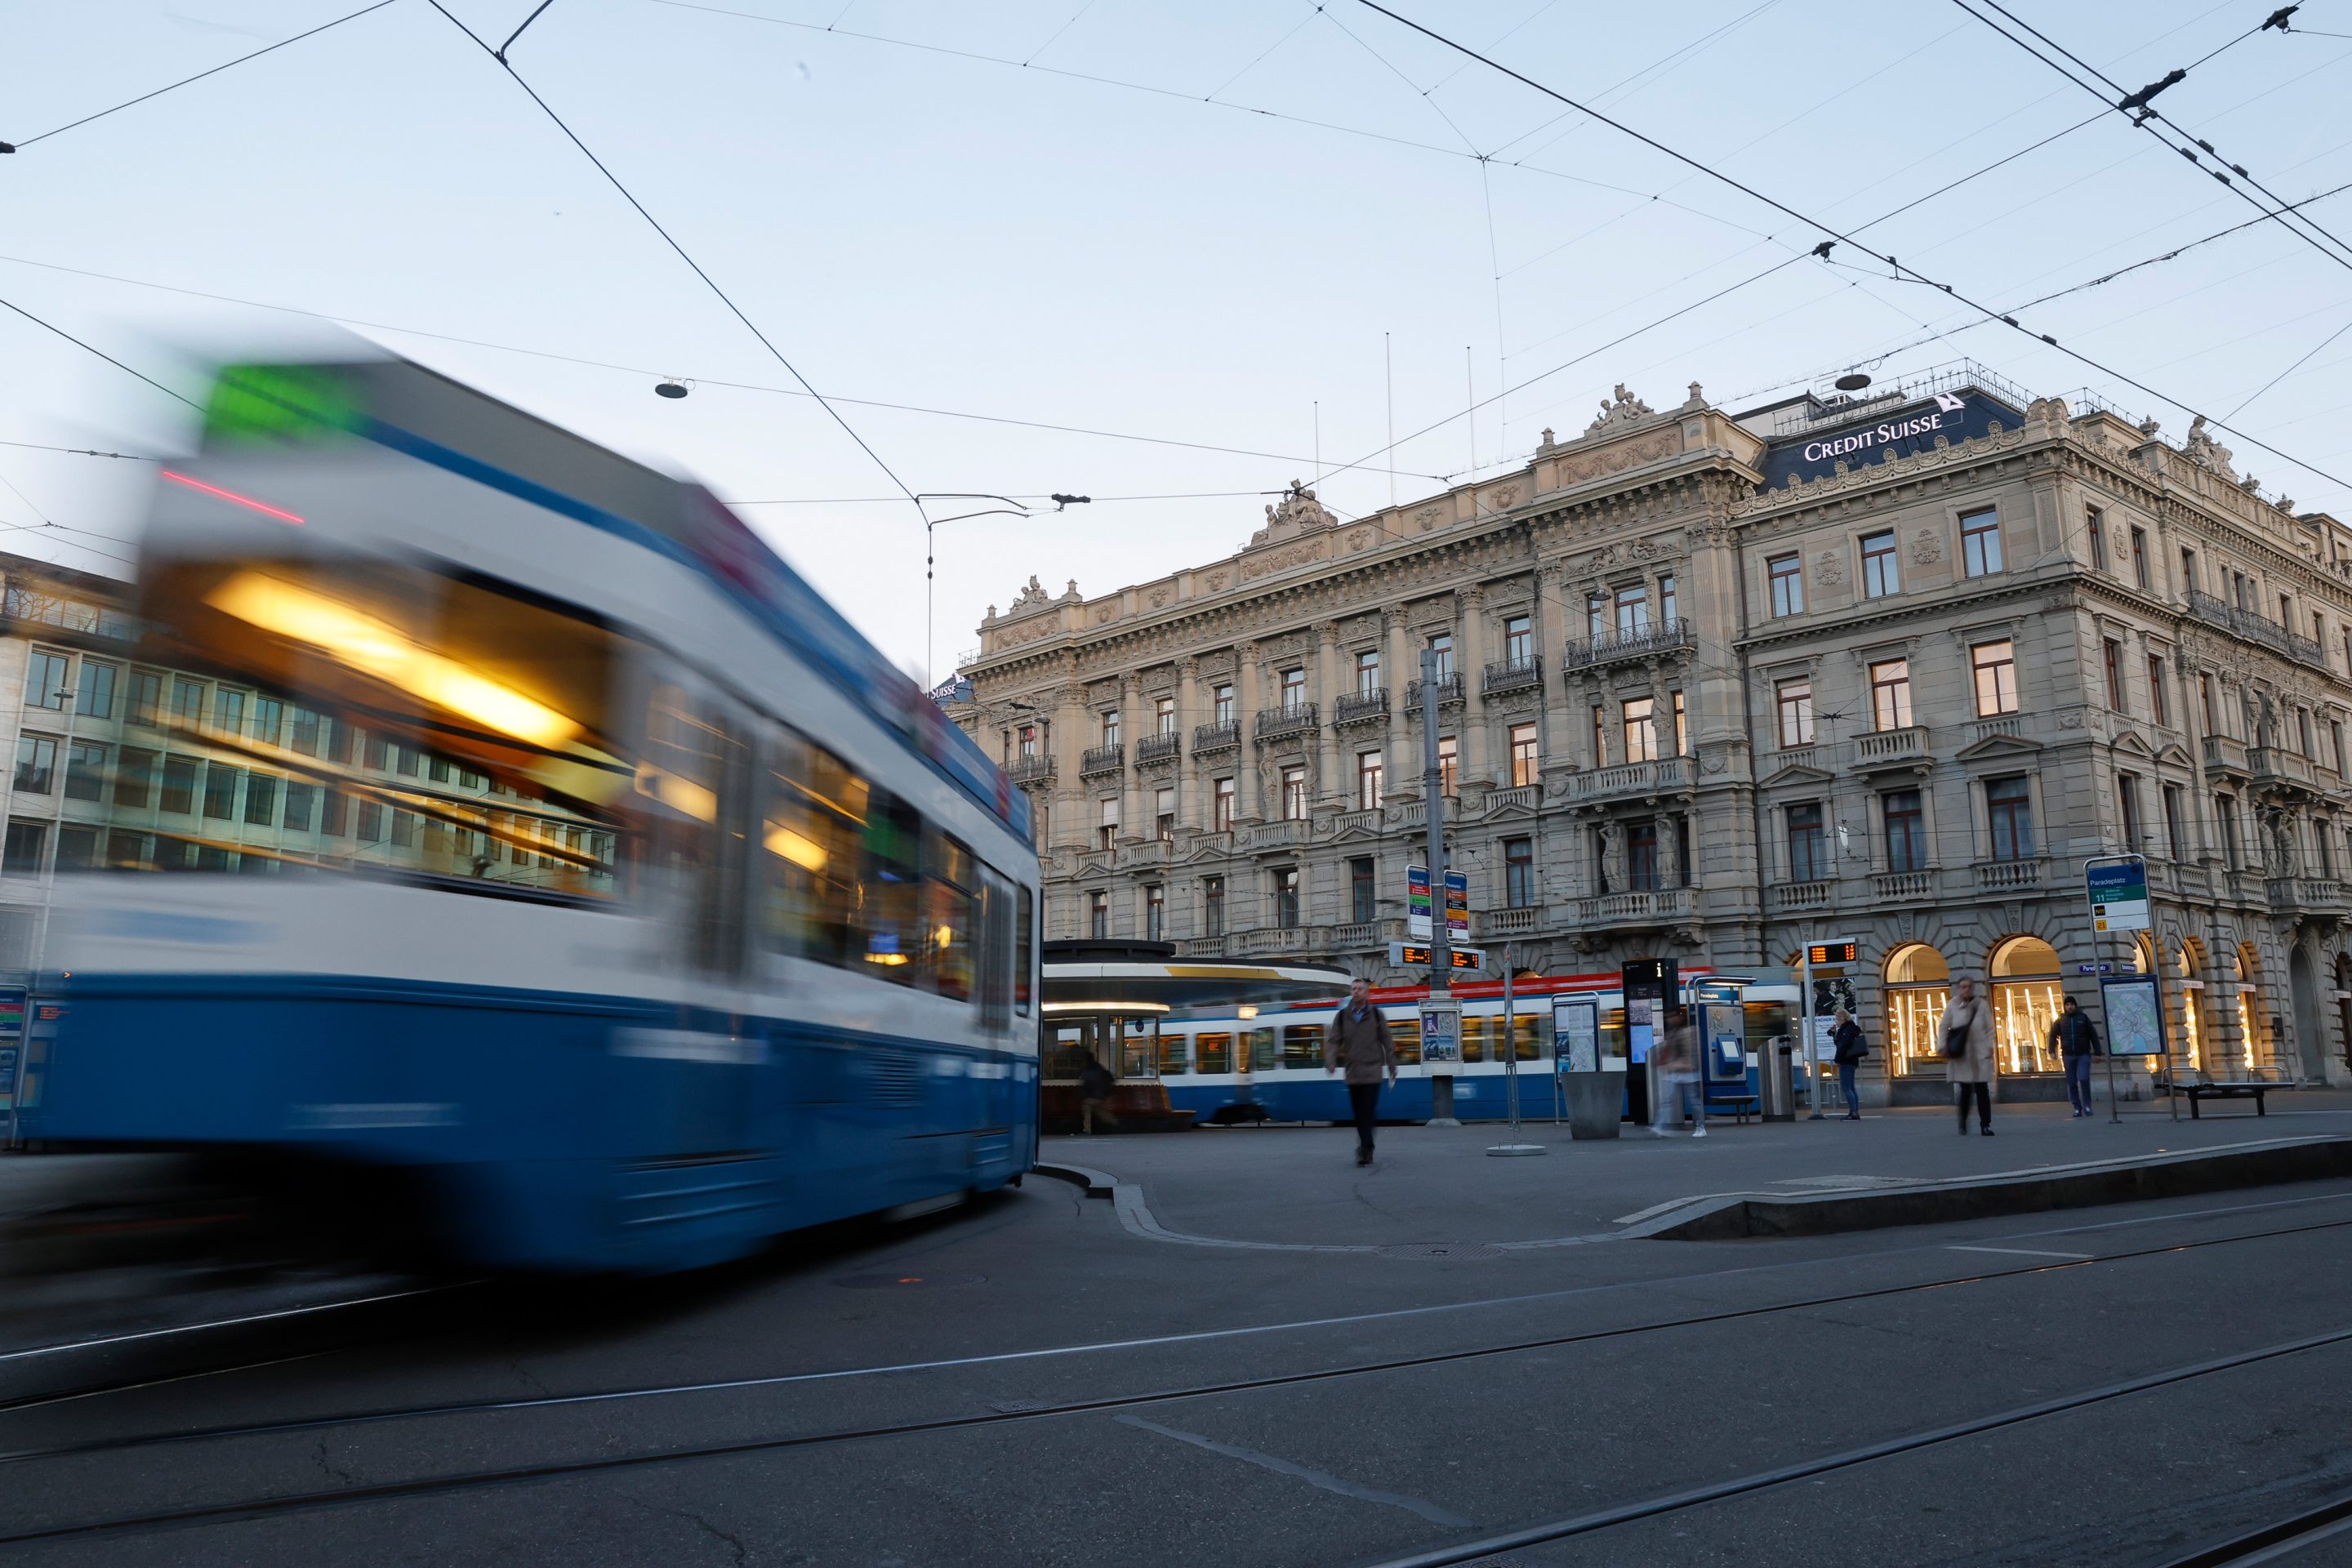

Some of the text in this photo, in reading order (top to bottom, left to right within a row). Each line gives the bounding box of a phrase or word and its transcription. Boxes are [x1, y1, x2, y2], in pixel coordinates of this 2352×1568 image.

[1804, 413, 1942, 461] CREDIT SUISSE
[2090, 878, 2126, 886] Paradeplatz
